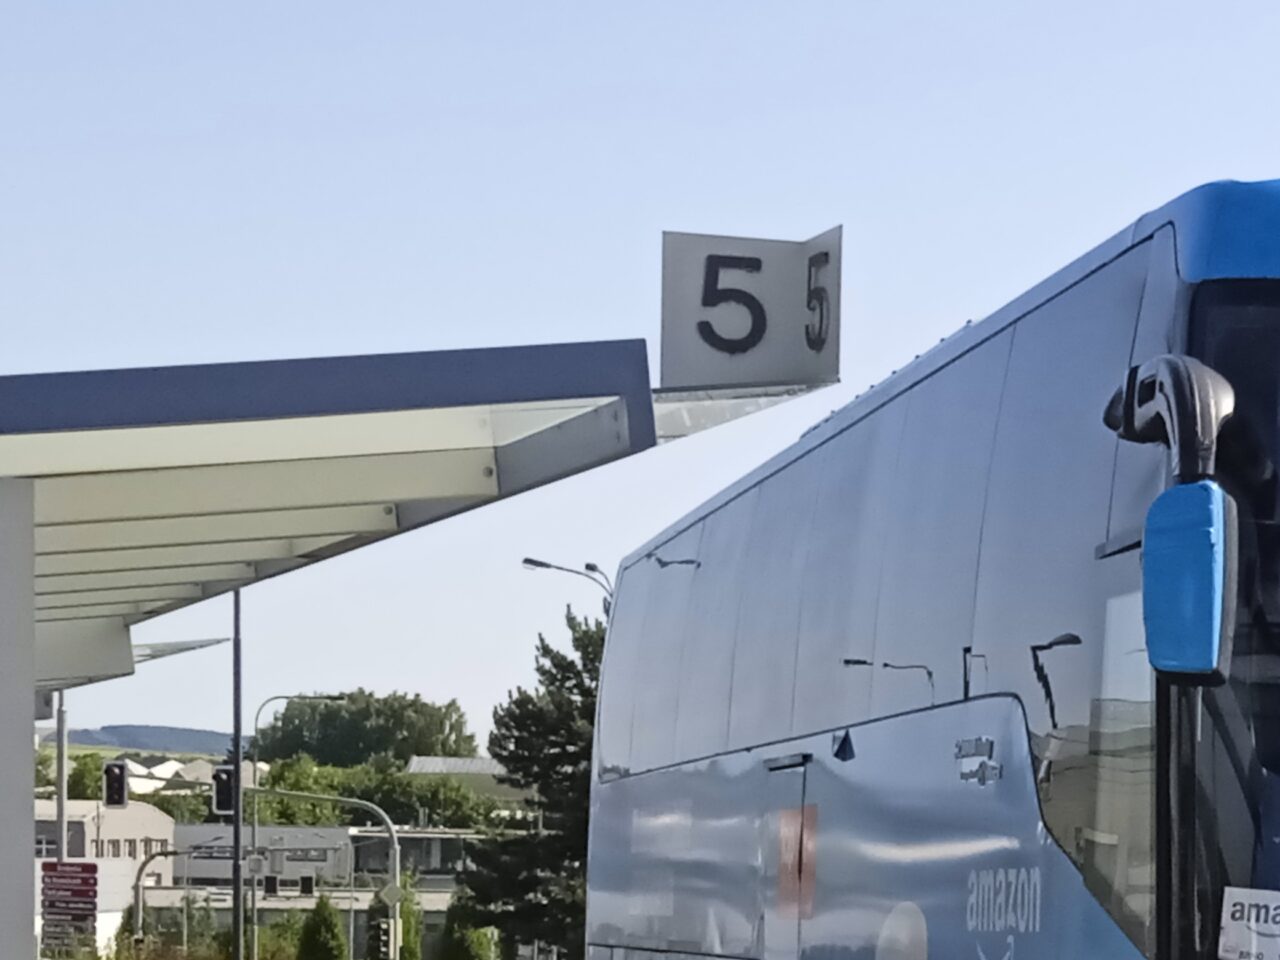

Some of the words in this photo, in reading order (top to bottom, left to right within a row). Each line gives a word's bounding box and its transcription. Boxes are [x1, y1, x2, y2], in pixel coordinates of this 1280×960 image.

[696, 254, 768, 355] 5
[805, 251, 830, 354] 5
[966, 866, 1042, 933] amazon
[1238, 950, 1265, 960] BRO
